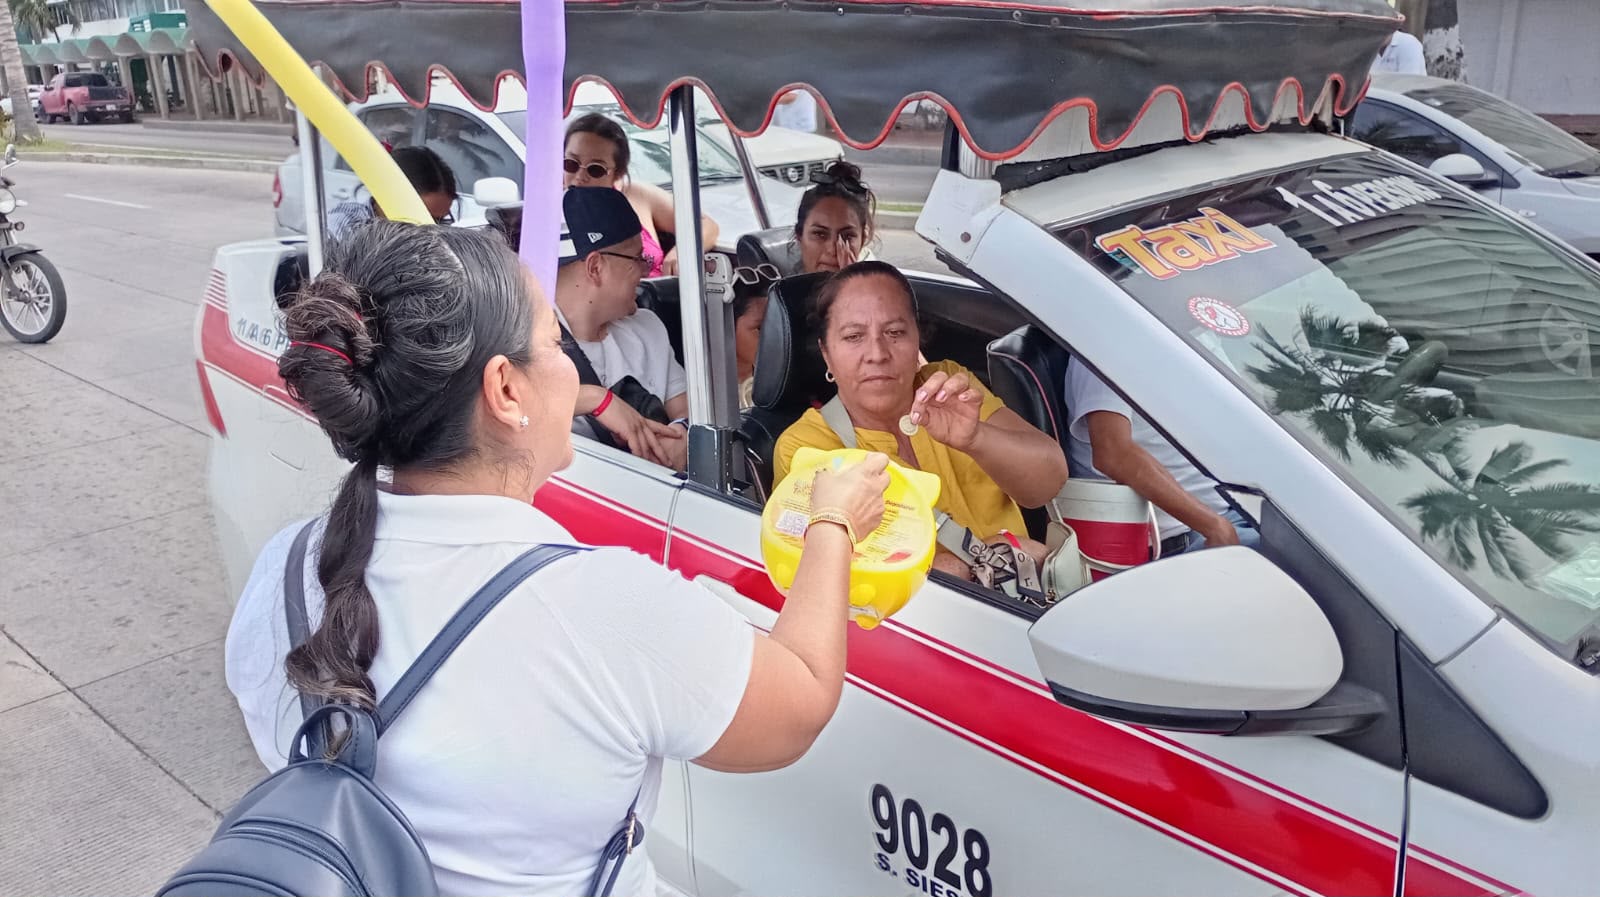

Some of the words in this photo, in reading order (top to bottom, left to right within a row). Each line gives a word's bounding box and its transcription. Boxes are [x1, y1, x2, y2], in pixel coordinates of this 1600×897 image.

[1275, 186, 1344, 227] 1
[1095, 207, 1277, 280] Taxi
[871, 783, 993, 897] 9028
